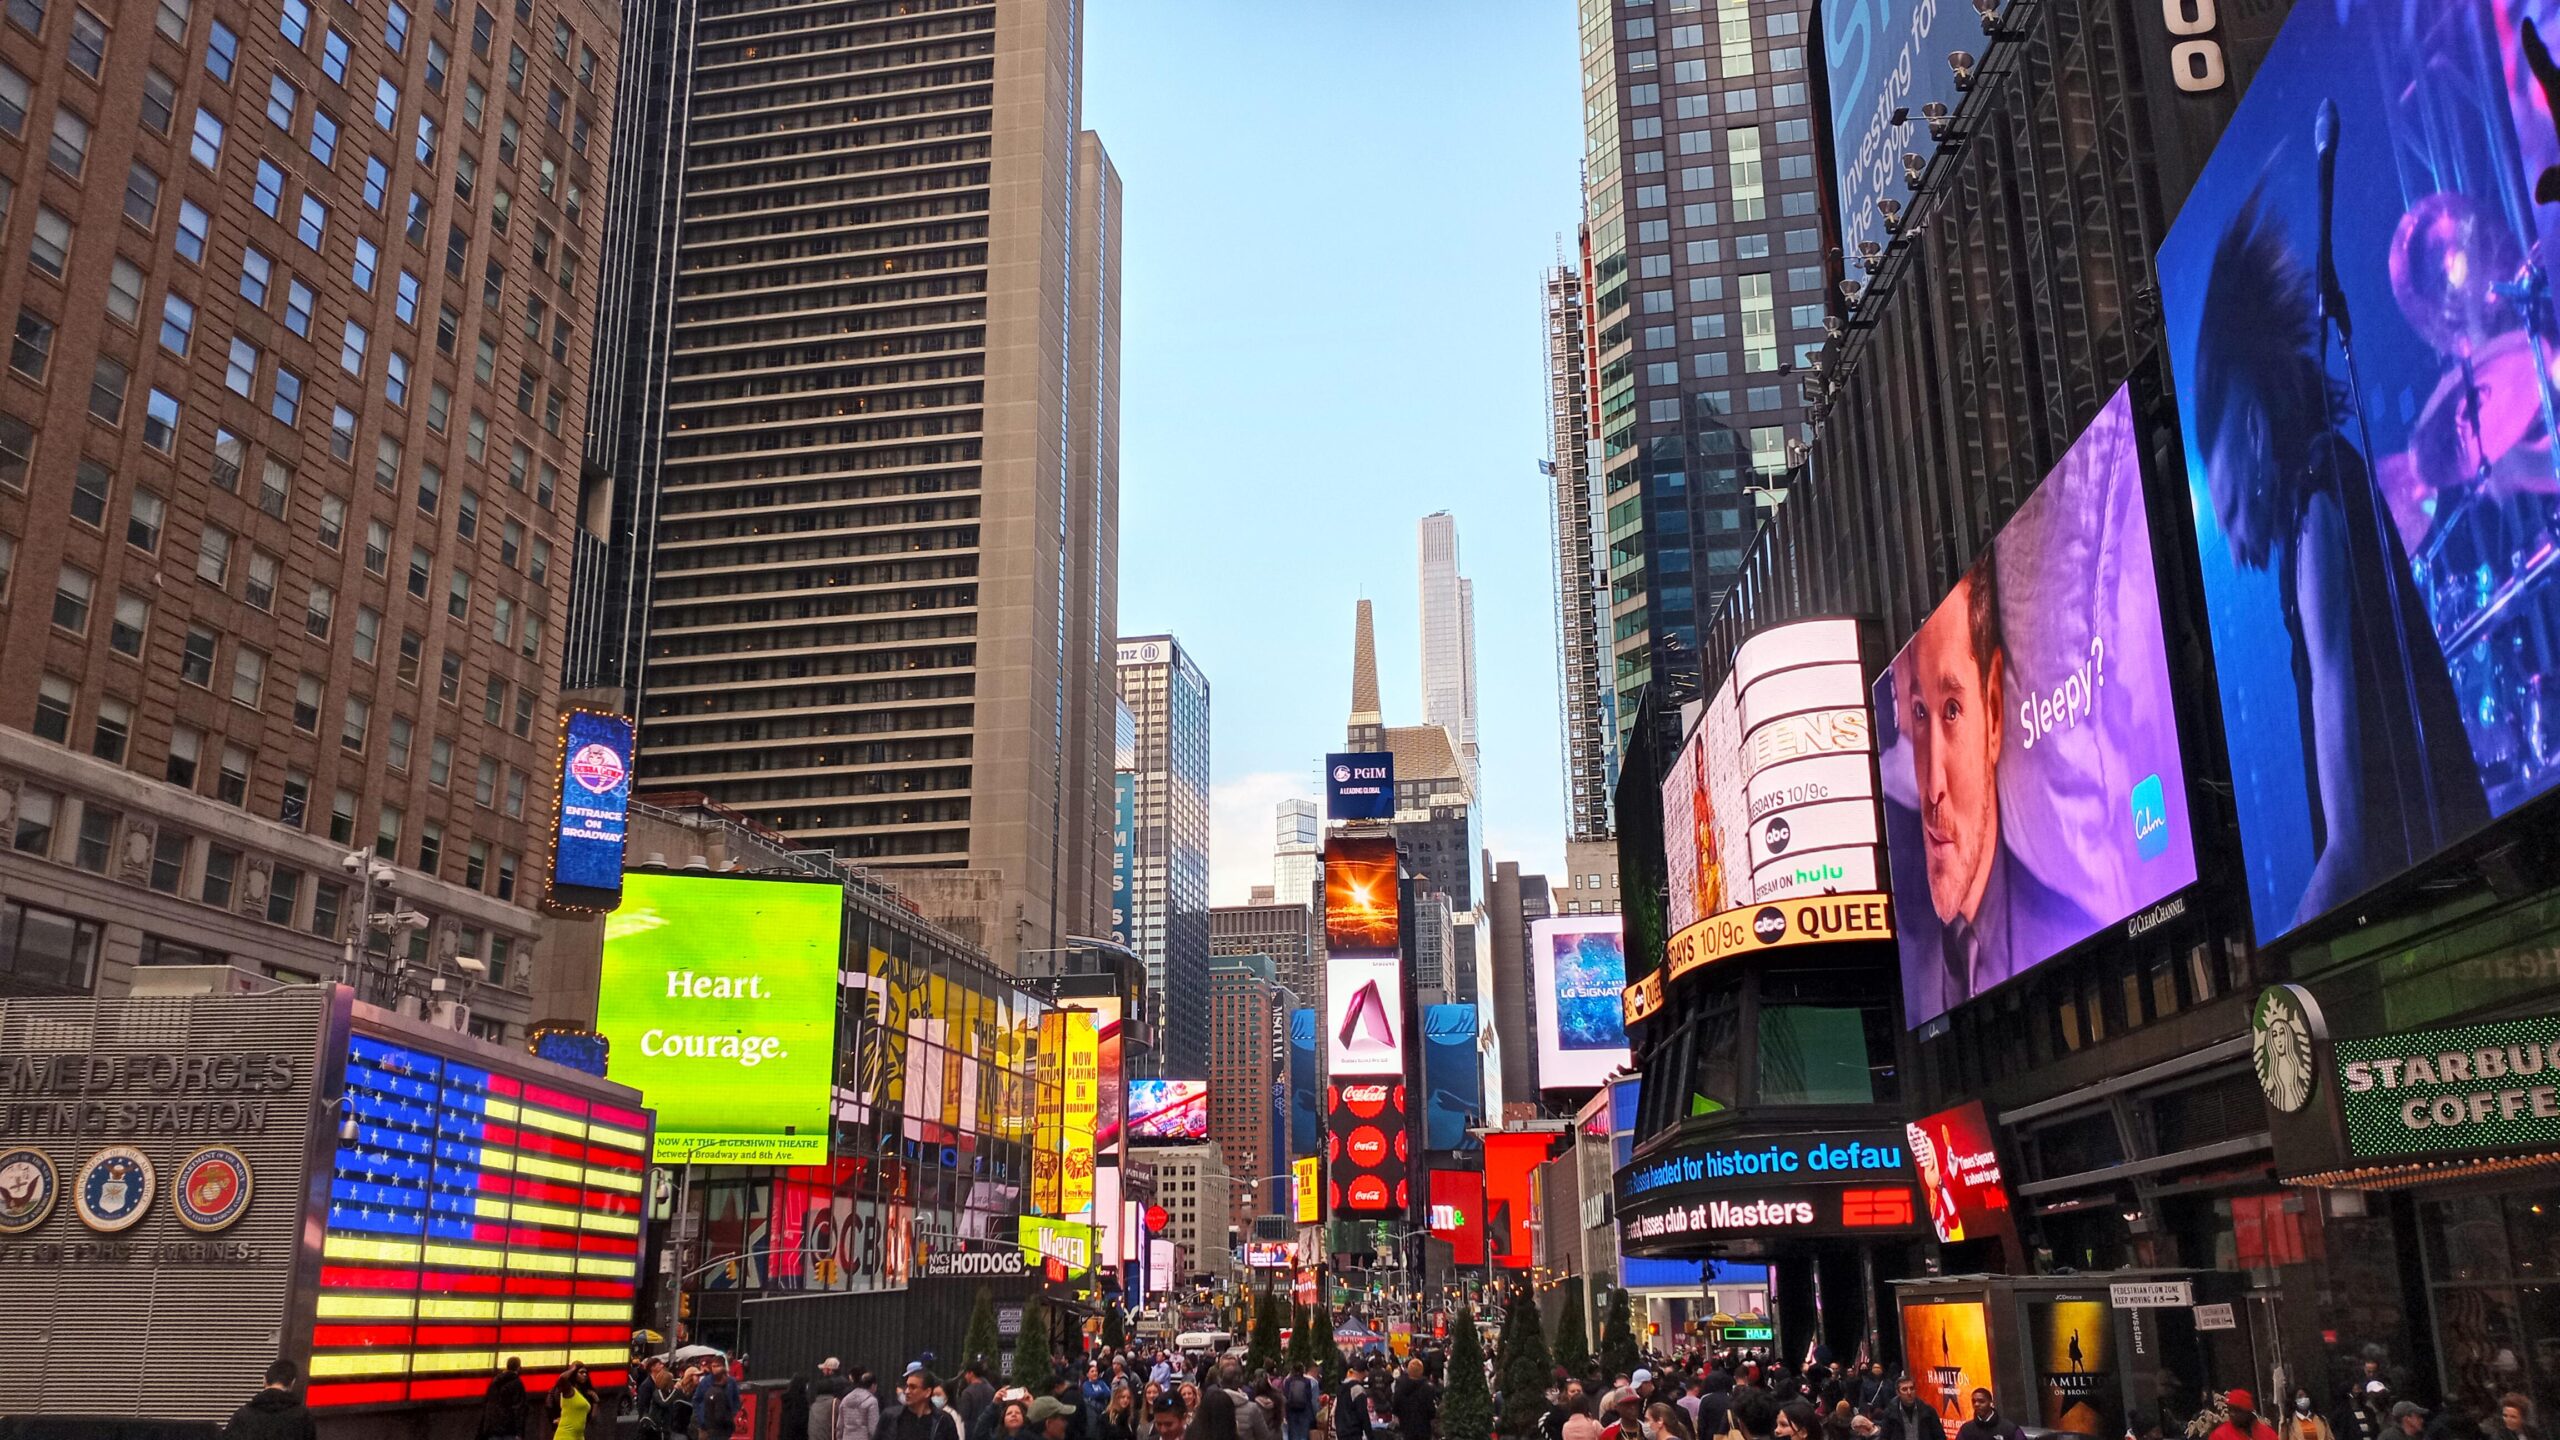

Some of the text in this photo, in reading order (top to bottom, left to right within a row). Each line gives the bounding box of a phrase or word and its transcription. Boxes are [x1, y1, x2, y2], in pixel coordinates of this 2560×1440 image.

[1842, 42, 1912, 214] Investing
[1911, 0, 1938, 54] for
[1847, 194, 1872, 252] the
[2020, 635, 2104, 749] Sleepy?
[1353, 767, 1386, 779] PGIM
[1787, 782, 1829, 803] 10/9c
[565, 805, 623, 821] ENTRANCE
[584, 819, 602, 829] ON
[2135, 807, 2165, 840] Calm
[562, 827, 622, 843] BROADWAY
[1766, 827, 1790, 844] abc
[1756, 863, 1843, 900] STREAM ON hulu
[1700, 920, 1745, 955] 10/9c
[1754, 915, 1786, 934] abc
[666, 970, 771, 999] Heart.
[1560, 988, 1576, 998] LG
[640, 1029, 788, 1065] Courage.
[1072, 1051, 1092, 1067] NOW
[123, 1052, 295, 1091] FORCES
[1067, 1067, 1097, 1080] PLAYING
[1076, 1085, 1086, 1098] ON
[1066, 1103, 1095, 1113] BROADWAY
[115, 1099, 268, 1134] STATION
[657, 1138, 819, 1149] NOW AT THE GERSHWIN THEATRE
[695, 1149, 739, 1160] Broadway
[740, 1150, 757, 1159] and
[758, 1150, 773, 1159] 8th
[775, 1151, 794, 1160] Ave.
[1650, 1157, 1682, 1188] headed
[1682, 1156, 1704, 1181] for
[1706, 1146, 1799, 1179] historic
[1807, 1141, 1902, 1171] defau
[1665, 1205, 1688, 1233] club
[1689, 1204, 1707, 1231] at
[1709, 1199, 1814, 1229] Masters
[928, 1263, 950, 1275] best
[950, 1252, 1022, 1274] HOTDOGS
[2113, 1285, 2180, 1295] PEDESTRIAN FLOW ZONE
[2114, 1295, 2152, 1305] KEEP MOVING
[1927, 1370, 1970, 1386] HAMILTON
